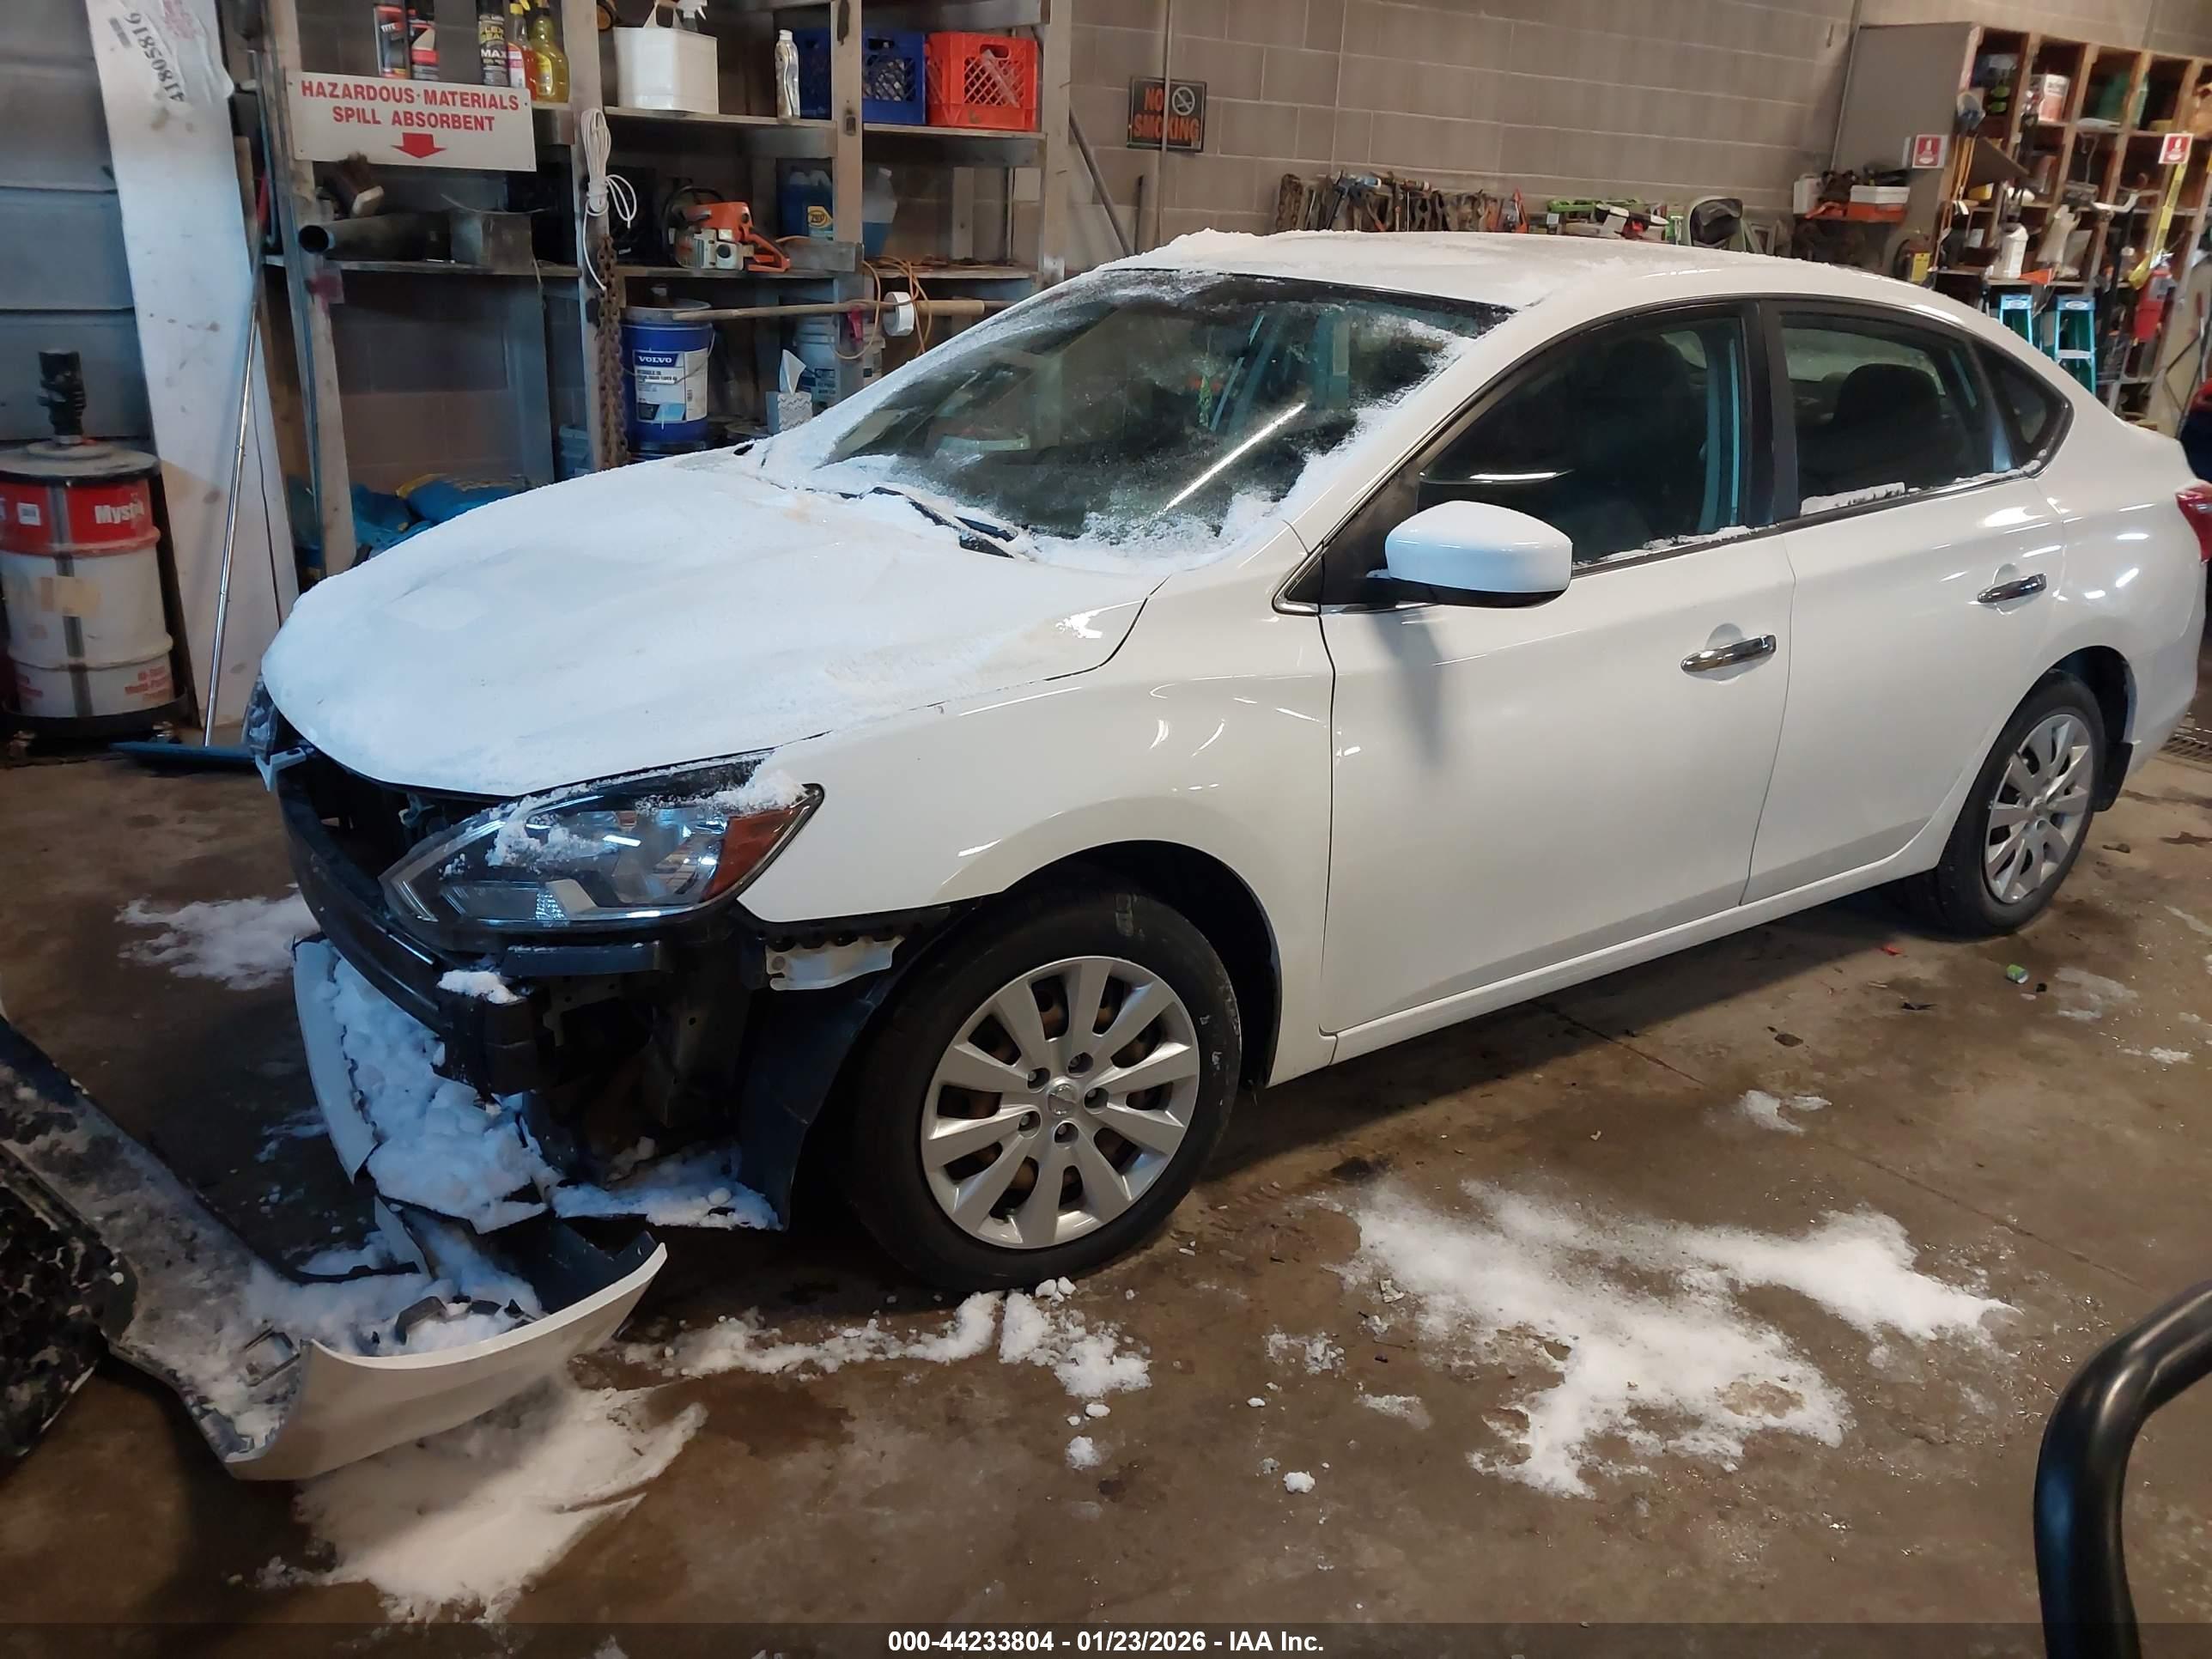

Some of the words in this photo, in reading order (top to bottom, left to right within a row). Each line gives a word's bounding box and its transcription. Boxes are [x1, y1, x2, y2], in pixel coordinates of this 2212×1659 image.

[124, 12, 185, 101] 41805816
[481, 49, 507, 58] MAX
[301, 81, 415, 104] HAZARDOUS
[423, 89, 520, 111] MATERIALS
[1144, 88, 1164, 111] NO
[332, 106, 381, 125] SPILL
[391, 111, 495, 131] ABSORBENT
[638, 356, 672, 364] VOLVO
